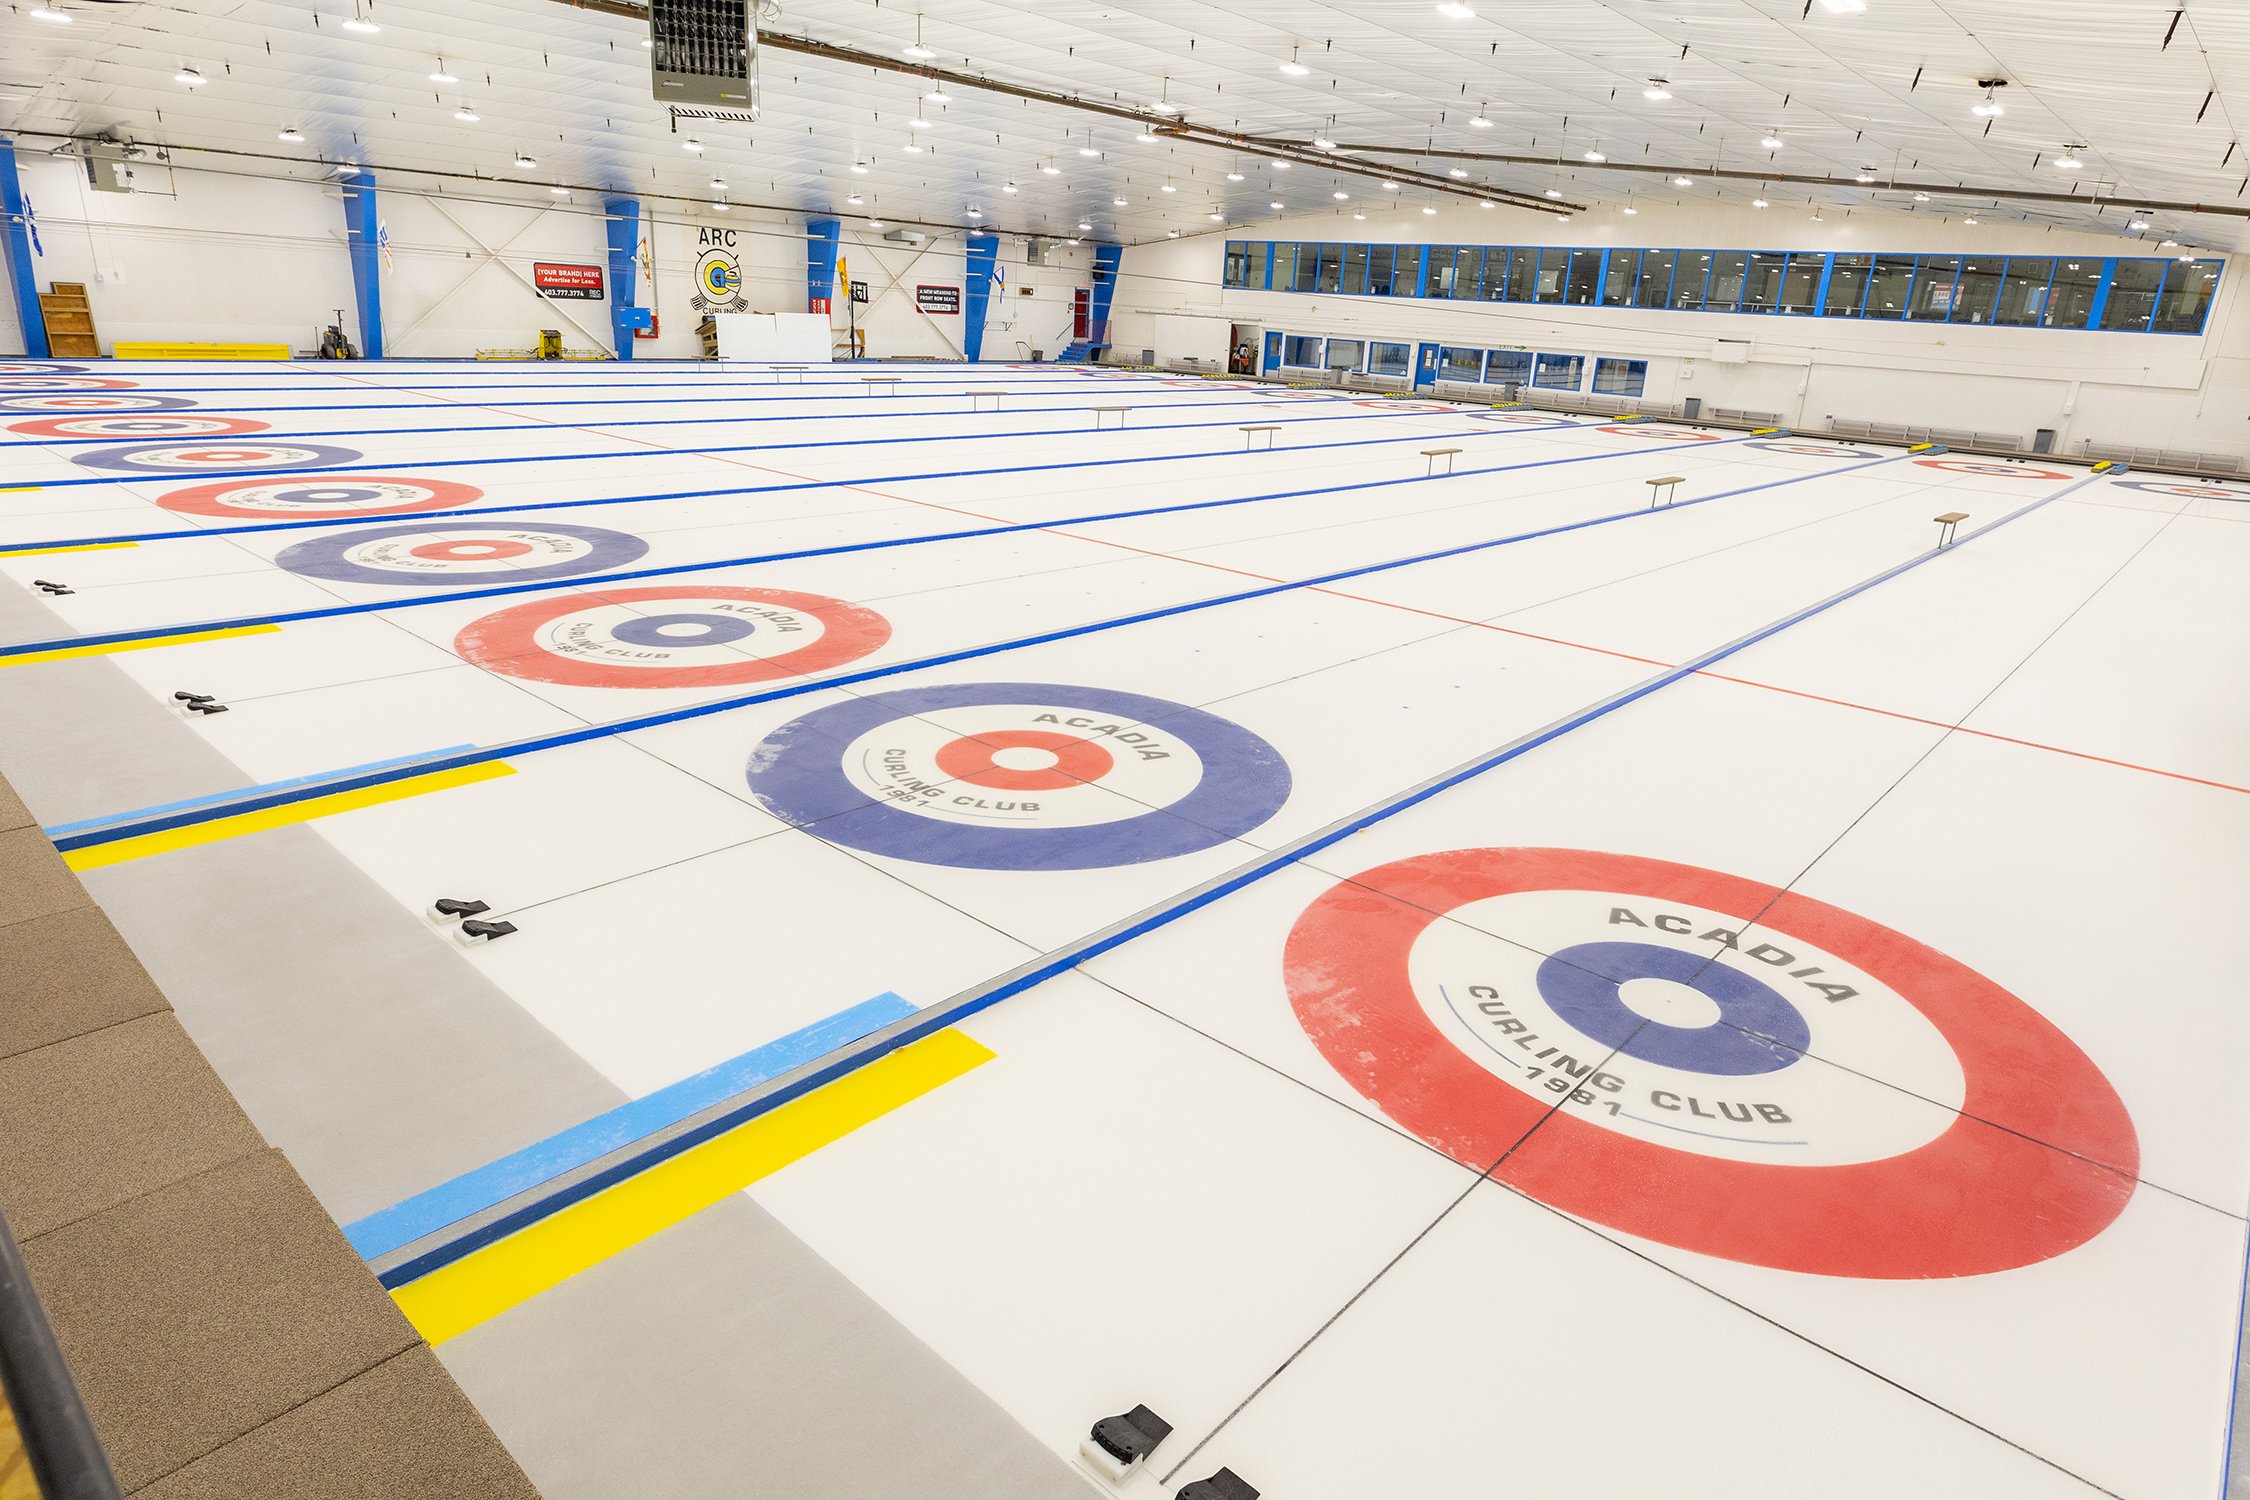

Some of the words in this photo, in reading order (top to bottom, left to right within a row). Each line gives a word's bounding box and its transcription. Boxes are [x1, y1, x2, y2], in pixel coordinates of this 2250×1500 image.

[699, 227, 737, 247] ARC
[544, 289, 584, 297] 403.777.3774
[702, 307, 737, 315] CURLING
[711, 604, 803, 632] ACADIA
[605, 648, 670, 659] CLUB
[1031, 713, 1171, 761] ACADIA
[883, 748, 946, 798] CURLING
[951, 796, 1041, 812] CLUB
[879, 784, 930, 807] 1981
[1608, 907, 1861, 1004] ACADIA
[1468, 984, 1627, 1094] CURLING
[1650, 1089, 1793, 1125] CLUB
[1521, 1065, 1623, 1117] 1981
